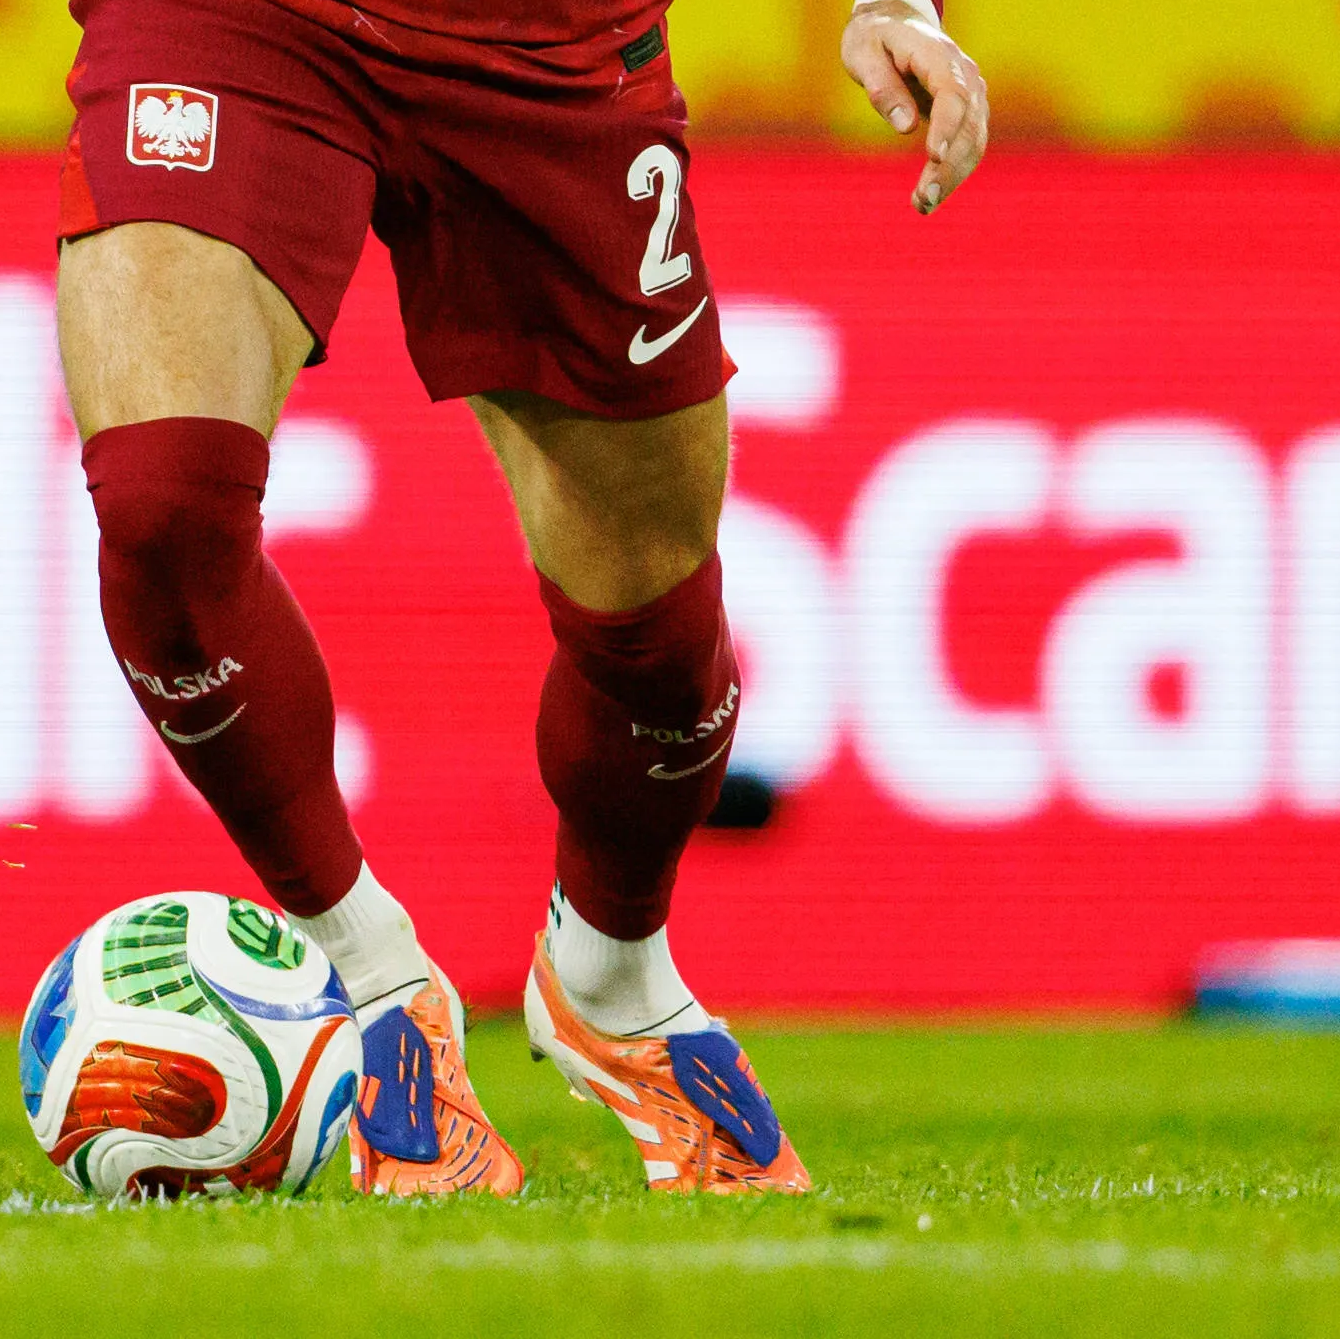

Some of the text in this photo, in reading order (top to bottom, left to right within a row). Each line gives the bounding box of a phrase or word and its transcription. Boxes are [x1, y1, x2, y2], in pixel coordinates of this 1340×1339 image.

[626, 144, 692, 297] 2
[124, 656, 244, 700] POLSKA
[631, 682, 739, 744] POLSKA
